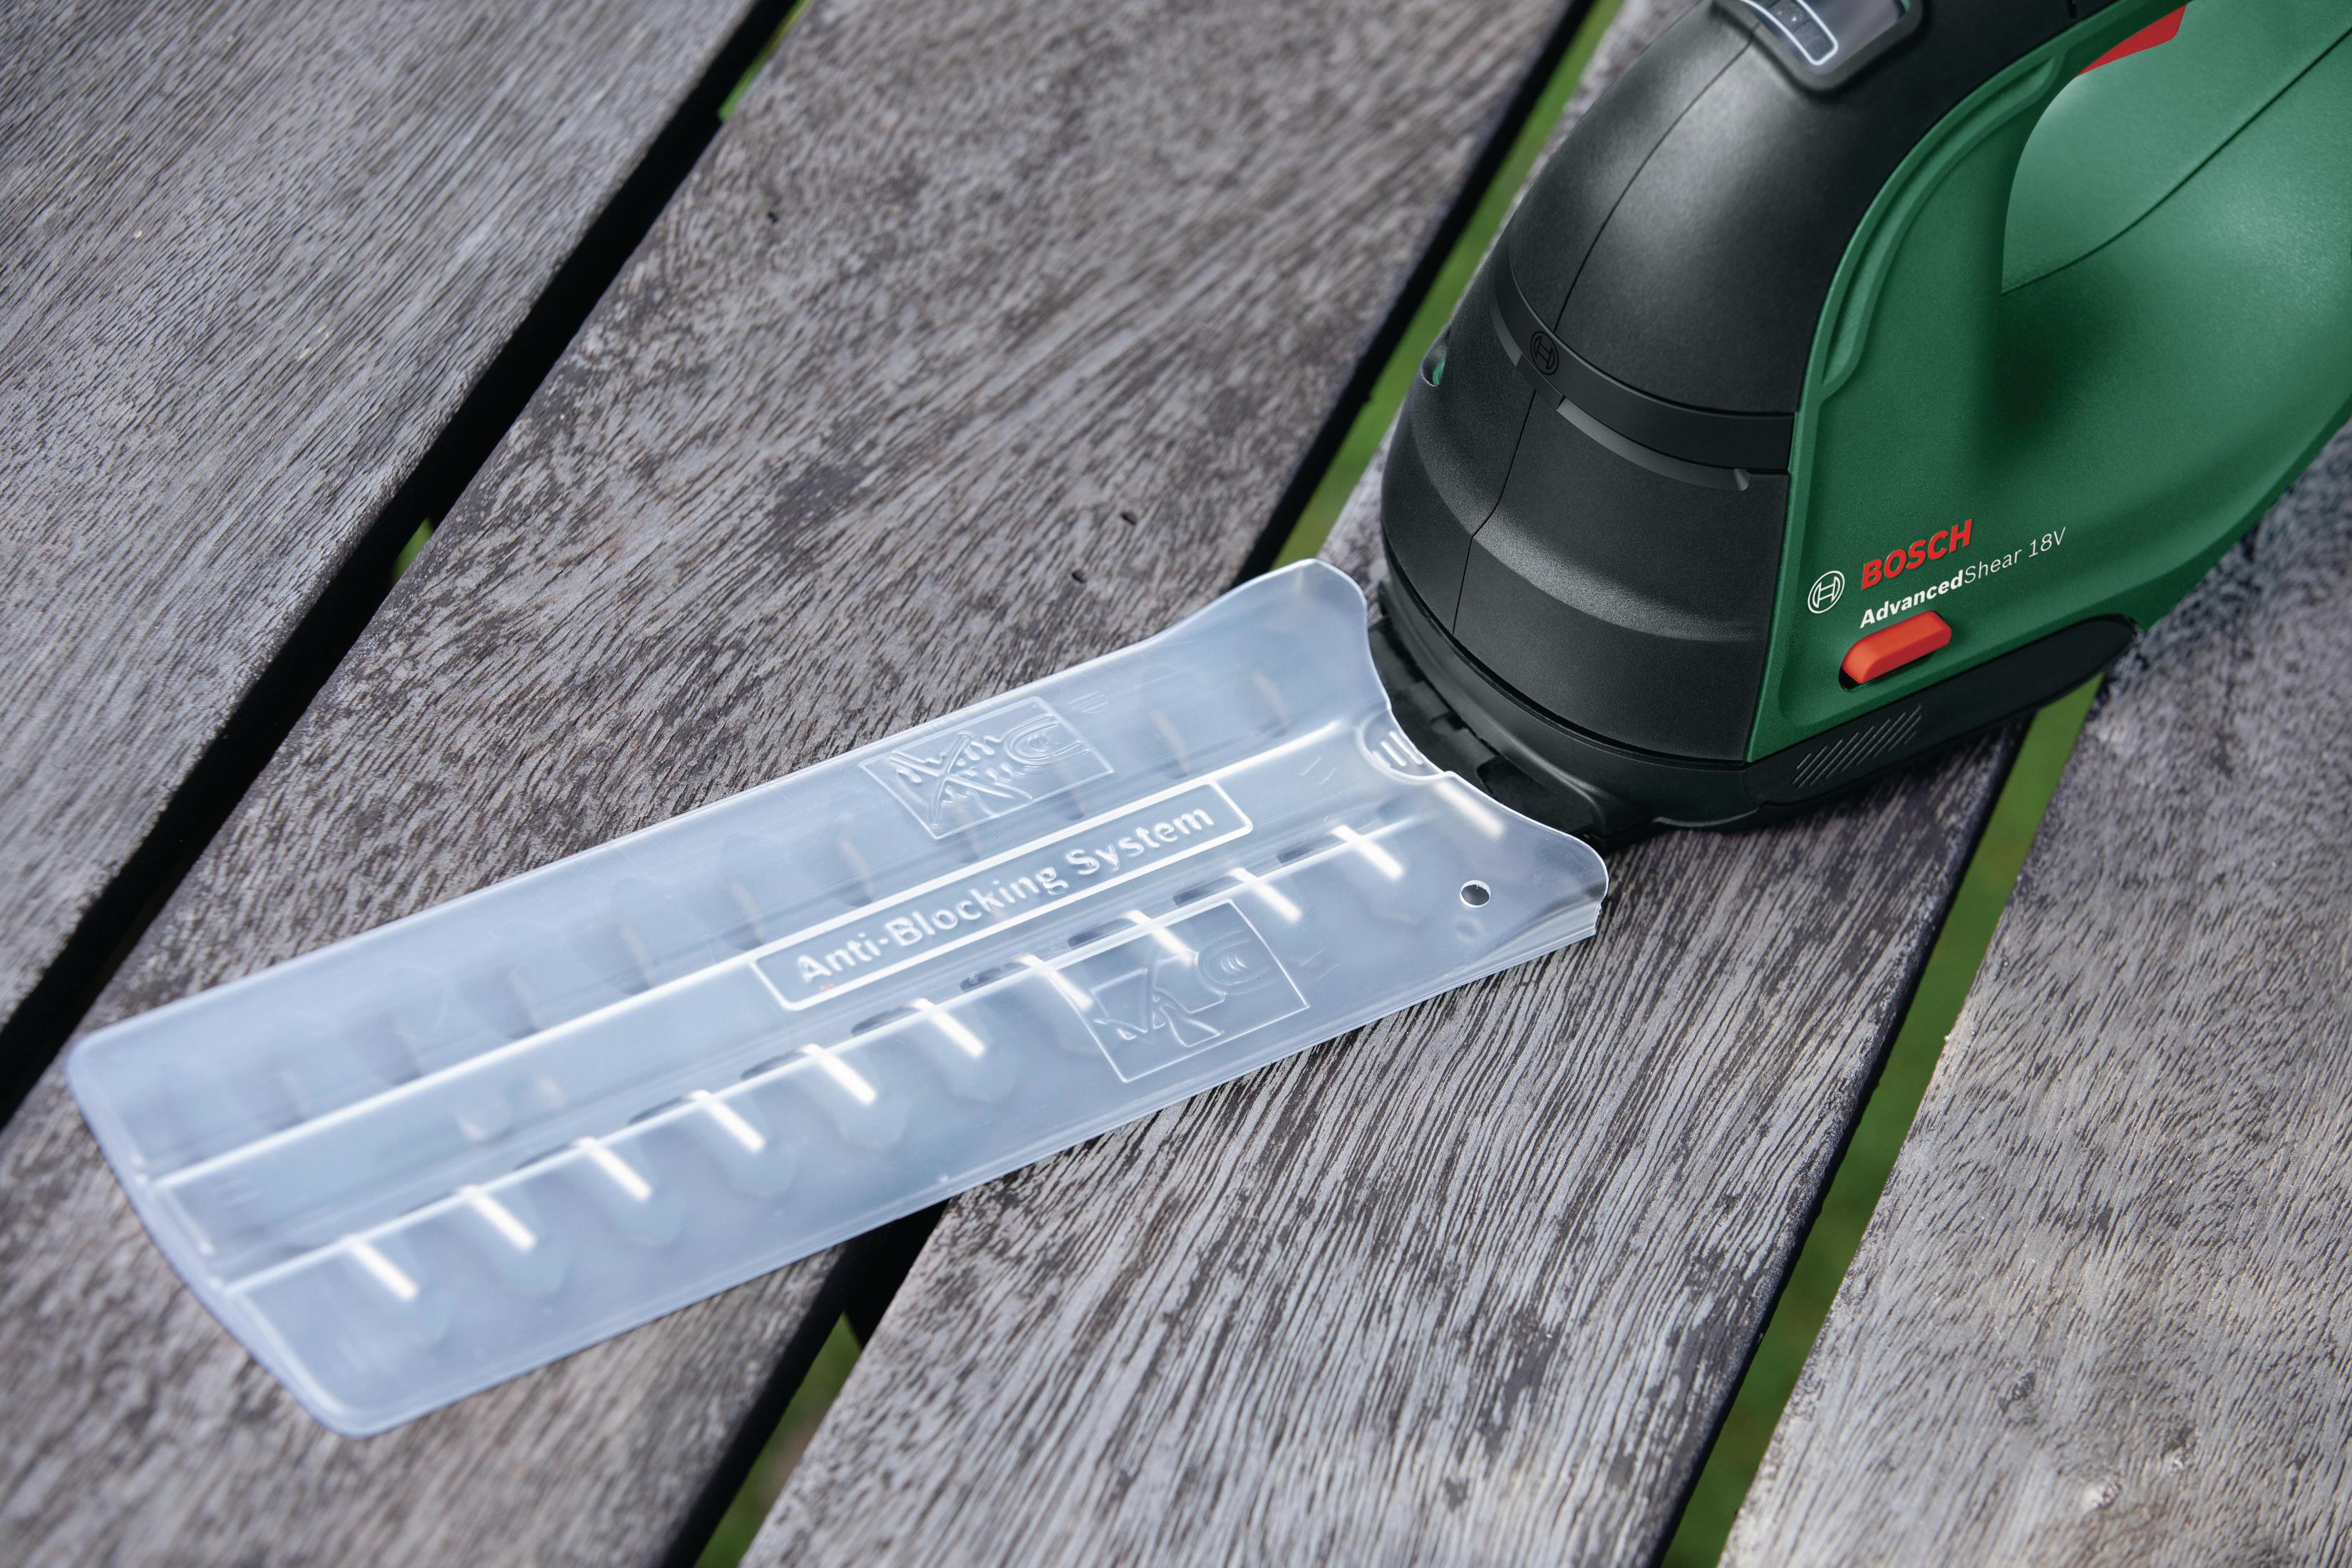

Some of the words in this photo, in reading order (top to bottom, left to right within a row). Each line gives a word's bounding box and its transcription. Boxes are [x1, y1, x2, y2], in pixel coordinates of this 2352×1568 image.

[1860, 548, 2022, 629] AdvancedShear
[2028, 527, 2066, 558] 18V
[1861, 519, 1973, 590] BOSCH
[796, 865, 1069, 984] Anti-Blocking
[1066, 806, 1214, 876] System
